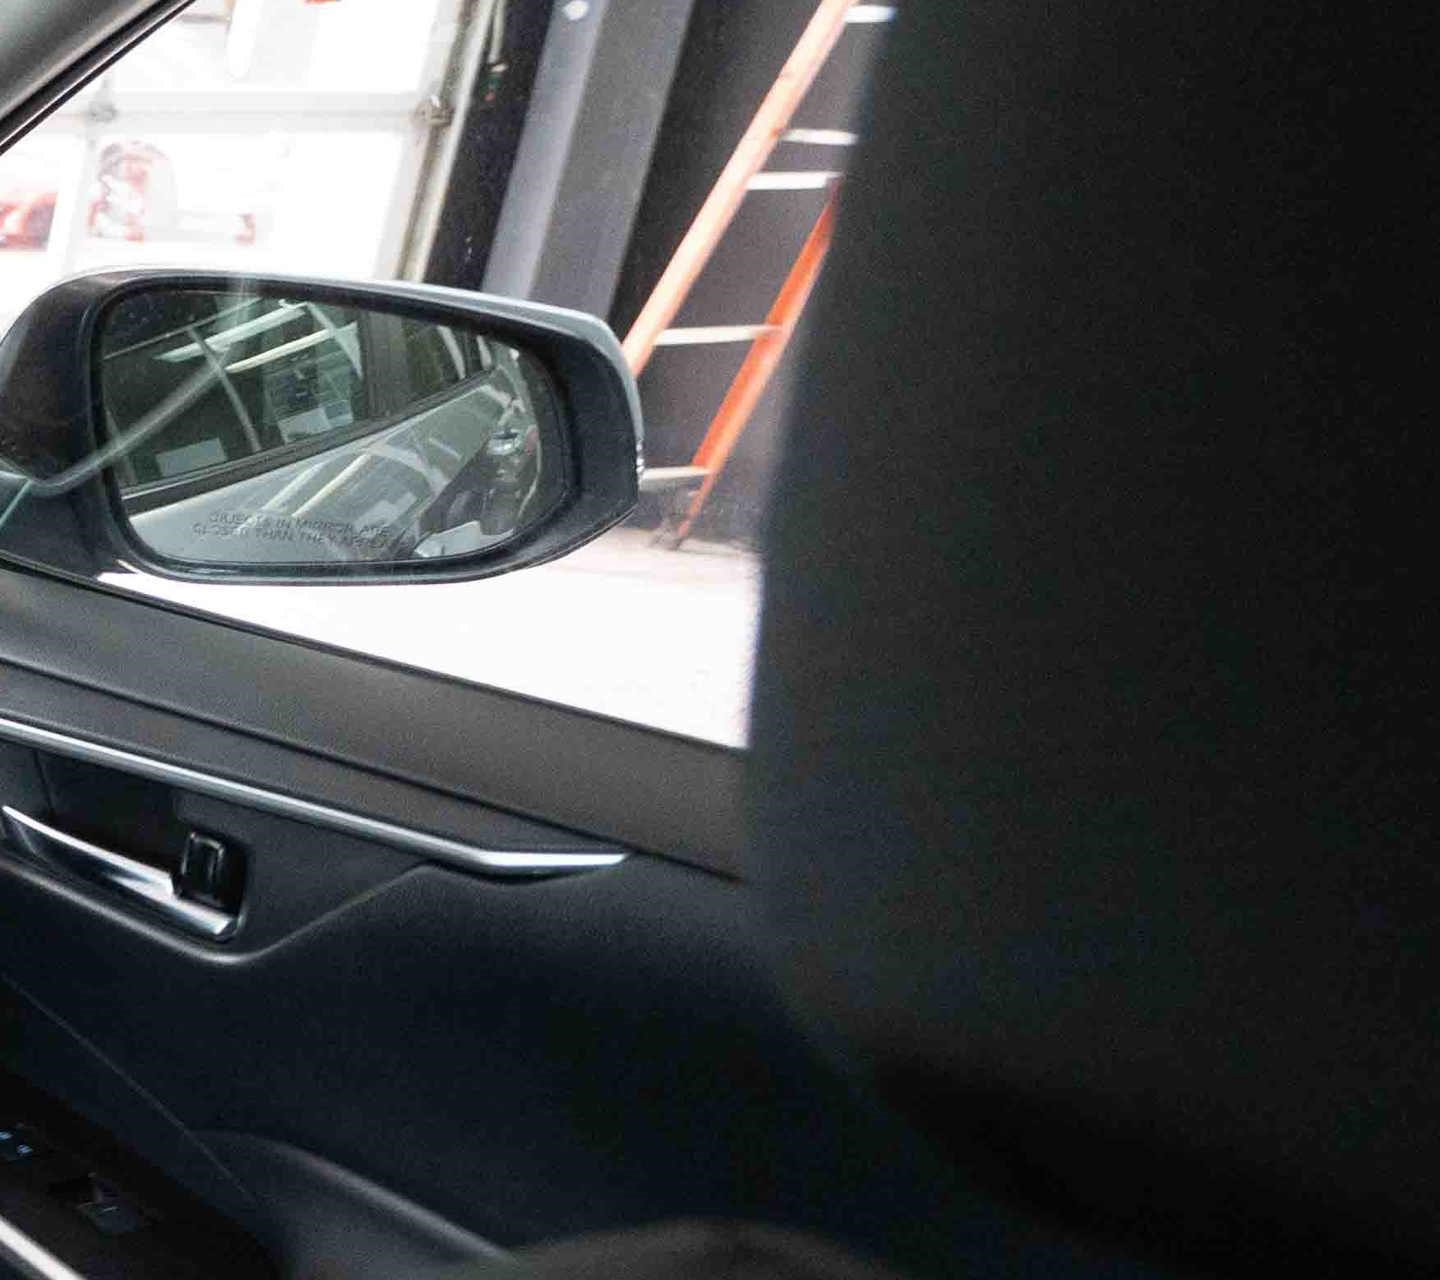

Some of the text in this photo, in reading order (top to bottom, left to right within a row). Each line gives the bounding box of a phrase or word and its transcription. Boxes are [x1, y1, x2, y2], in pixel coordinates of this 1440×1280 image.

[209, 511, 272, 528] OBJECTS
[295, 518, 355, 532] MIRROR
[192, 523, 247, 536] CLOSER
[255, 527, 293, 542] THAN
